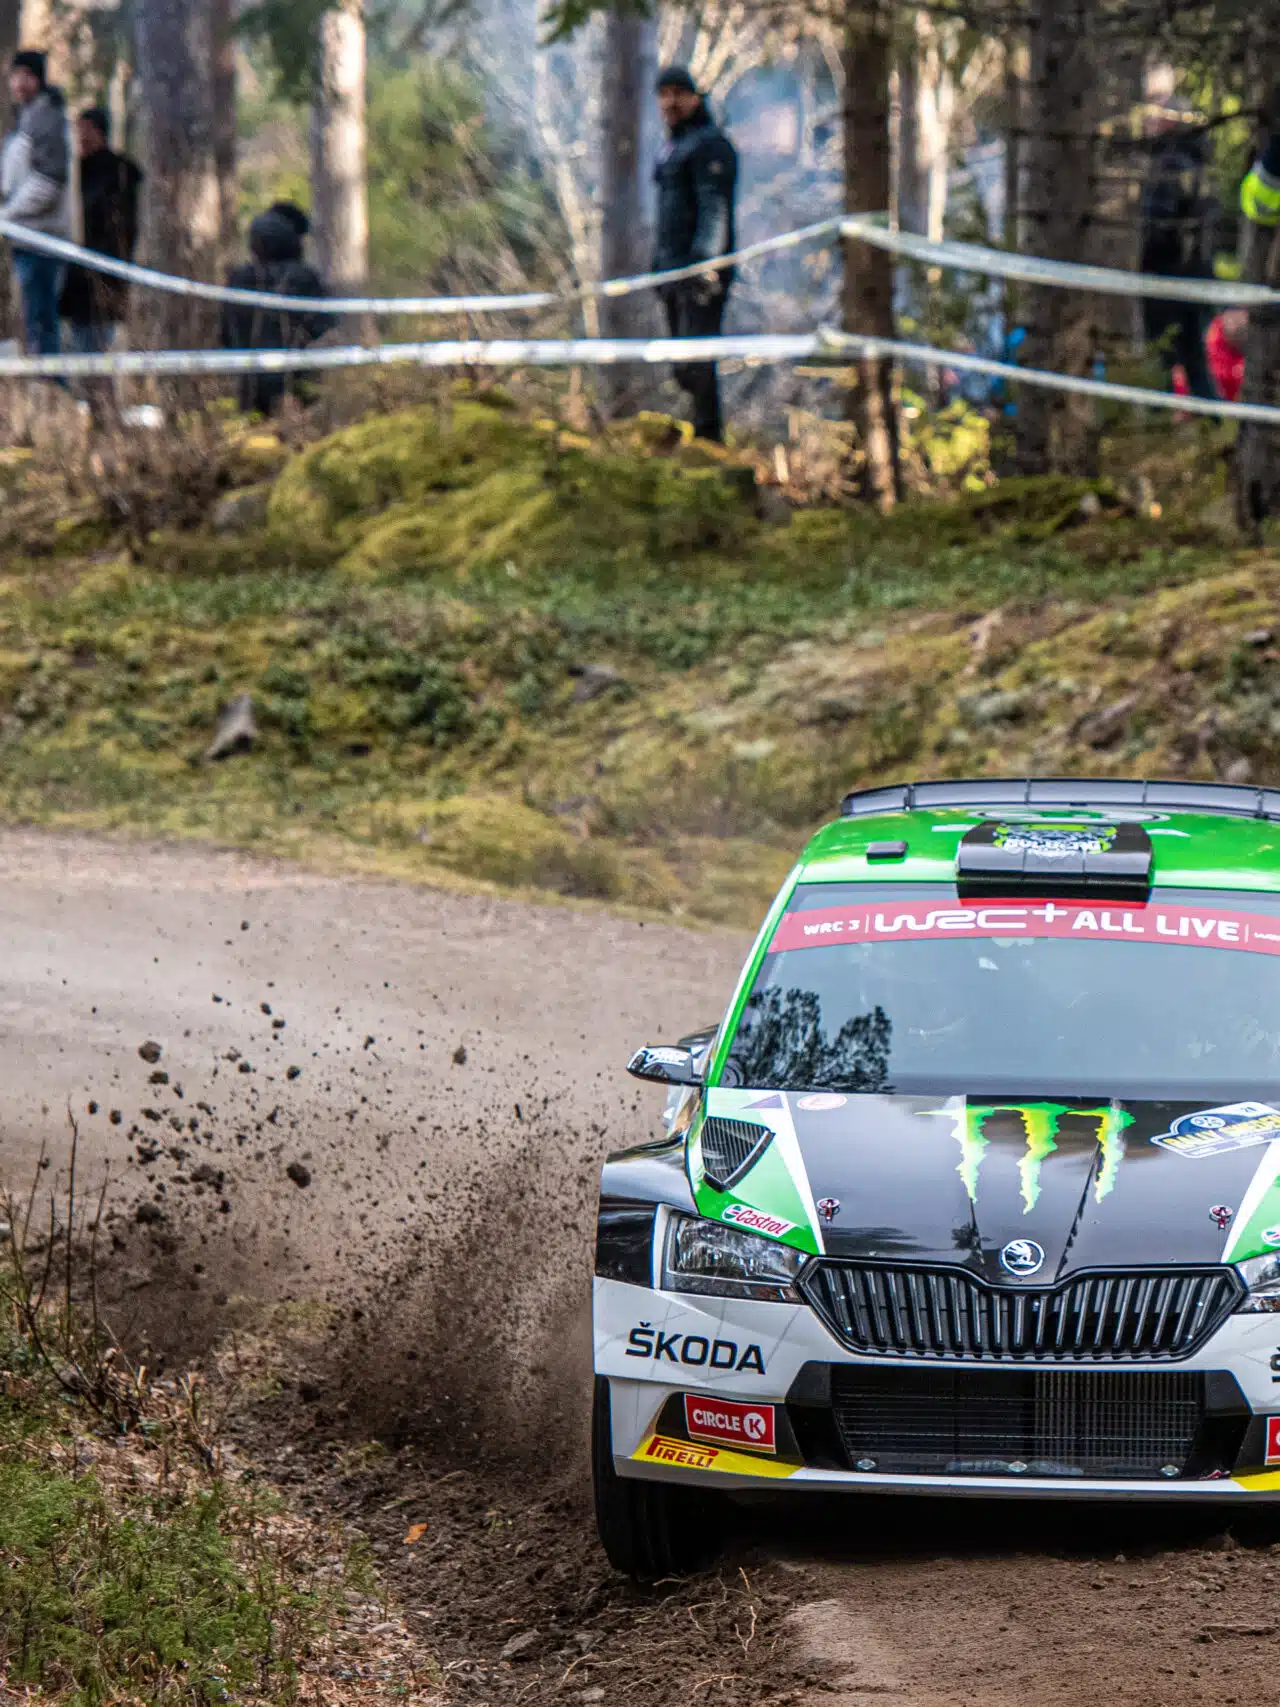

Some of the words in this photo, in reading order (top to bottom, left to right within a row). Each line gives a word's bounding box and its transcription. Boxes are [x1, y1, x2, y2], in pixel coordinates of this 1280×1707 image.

[803, 921, 844, 935] WRC
[848, 919, 860, 931] 3
[1072, 910, 1145, 933] ALL
[1156, 915, 1240, 942] LIVE
[735, 1209, 790, 1235] Castrol
[625, 1321, 766, 1375] ŠKODA
[692, 1408, 741, 1432] CIRCLE
[743, 1412, 766, 1440] K
[646, 1436, 719, 1468] PIRELLI
